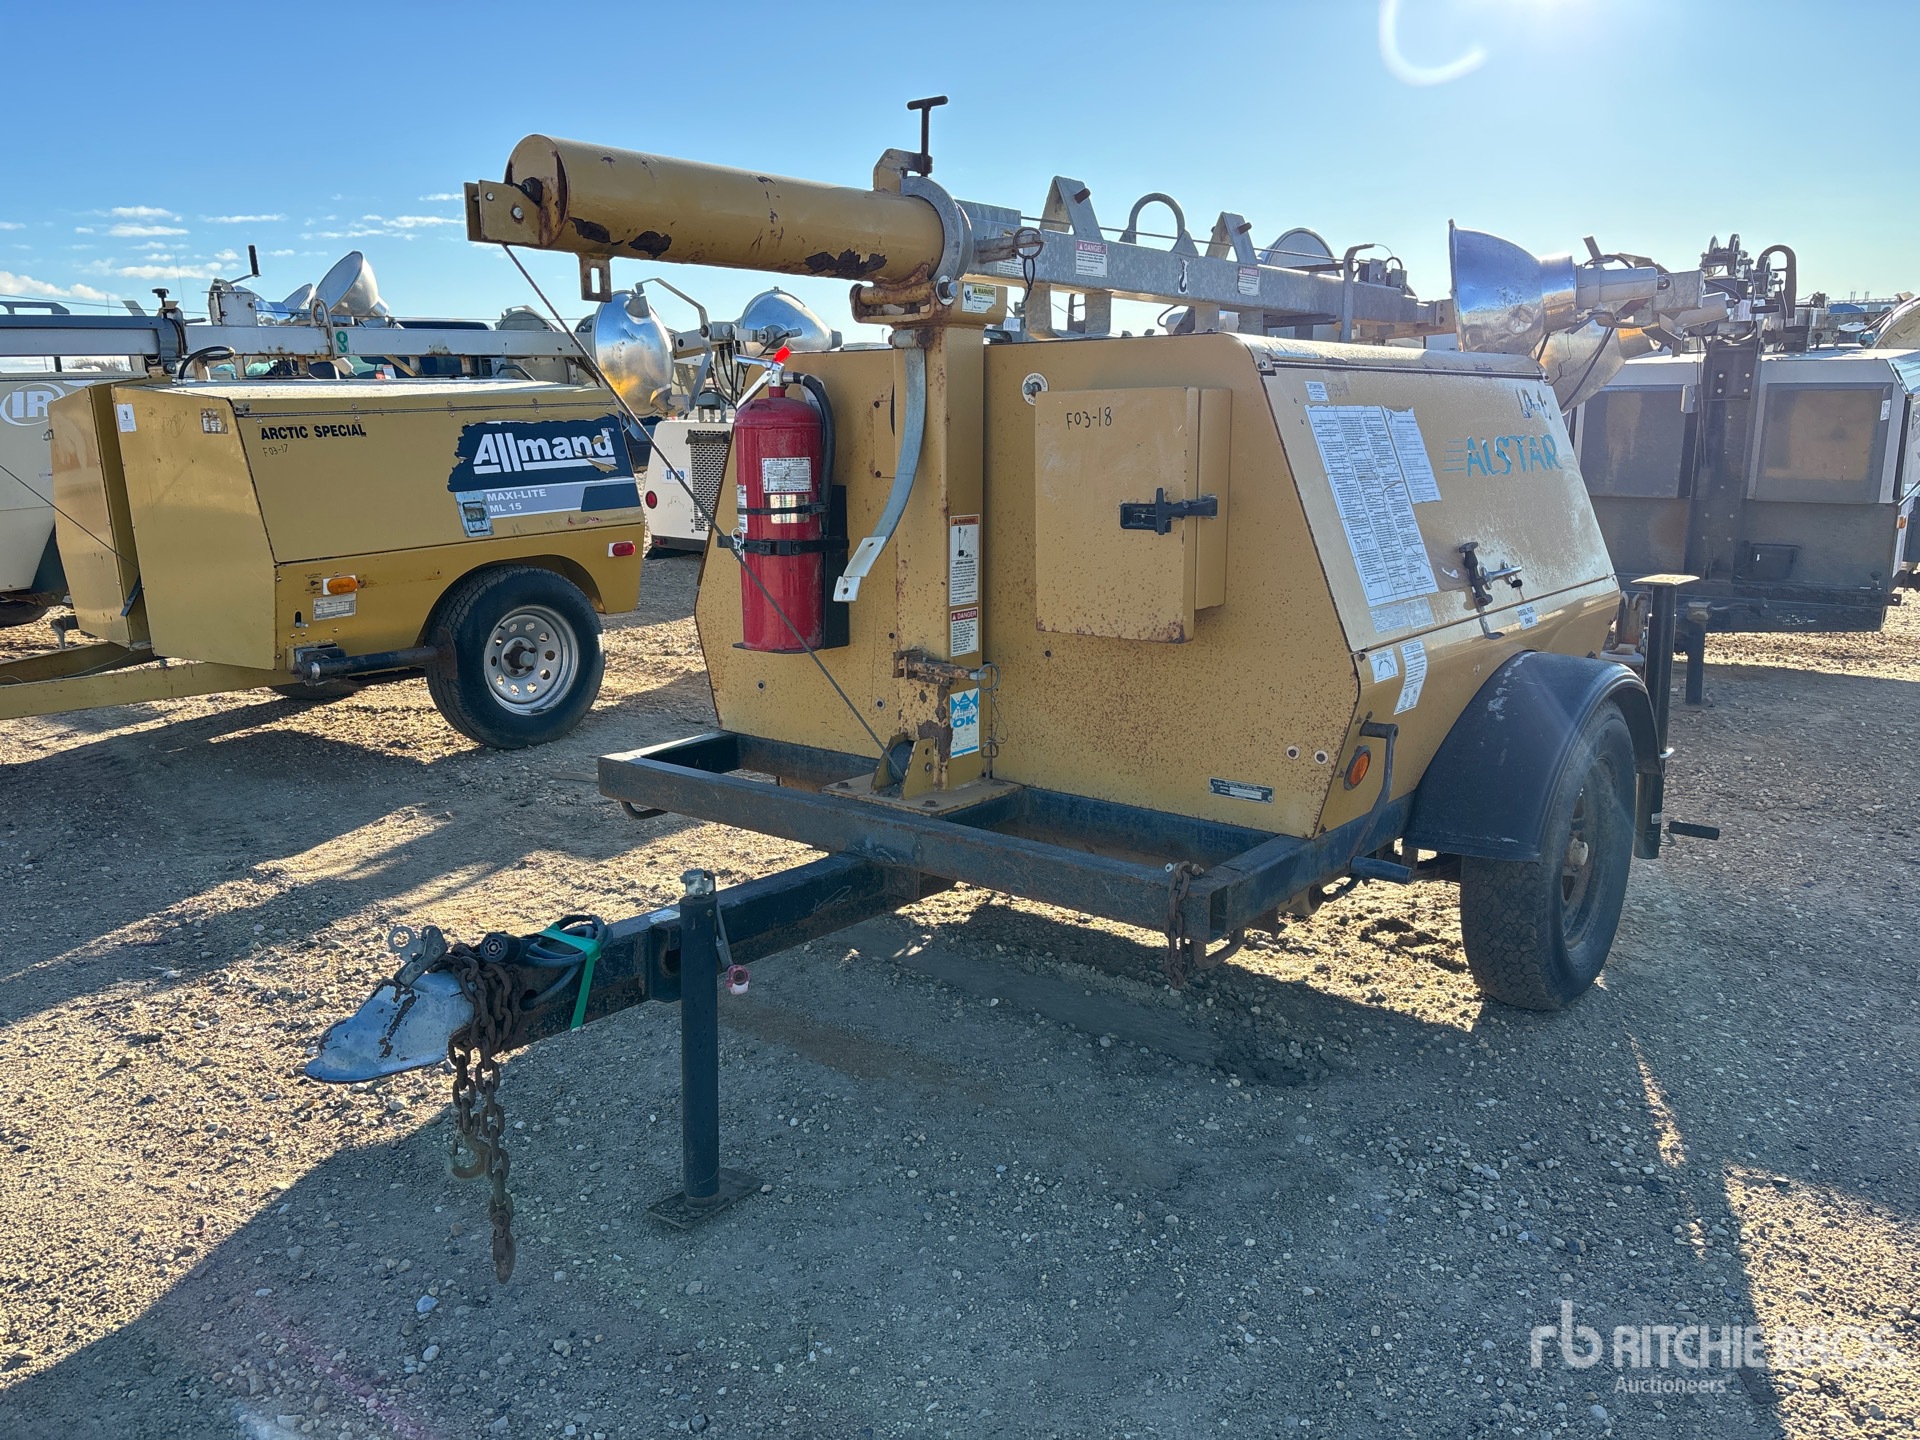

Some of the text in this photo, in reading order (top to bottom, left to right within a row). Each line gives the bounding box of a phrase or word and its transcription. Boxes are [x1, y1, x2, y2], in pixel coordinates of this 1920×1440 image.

[1066, 406, 1112, 430] F03-18
[261, 424, 367, 440] ARCTIC SPECIAL
[473, 427, 615, 474] Allmand
[1466, 433, 1563, 478] ALSTAR
[486, 488, 547, 502] MAXI-LITE
[489, 502, 522, 513] ML 15
[956, 610, 977, 620] DANGER
[952, 714, 977, 728] OK
